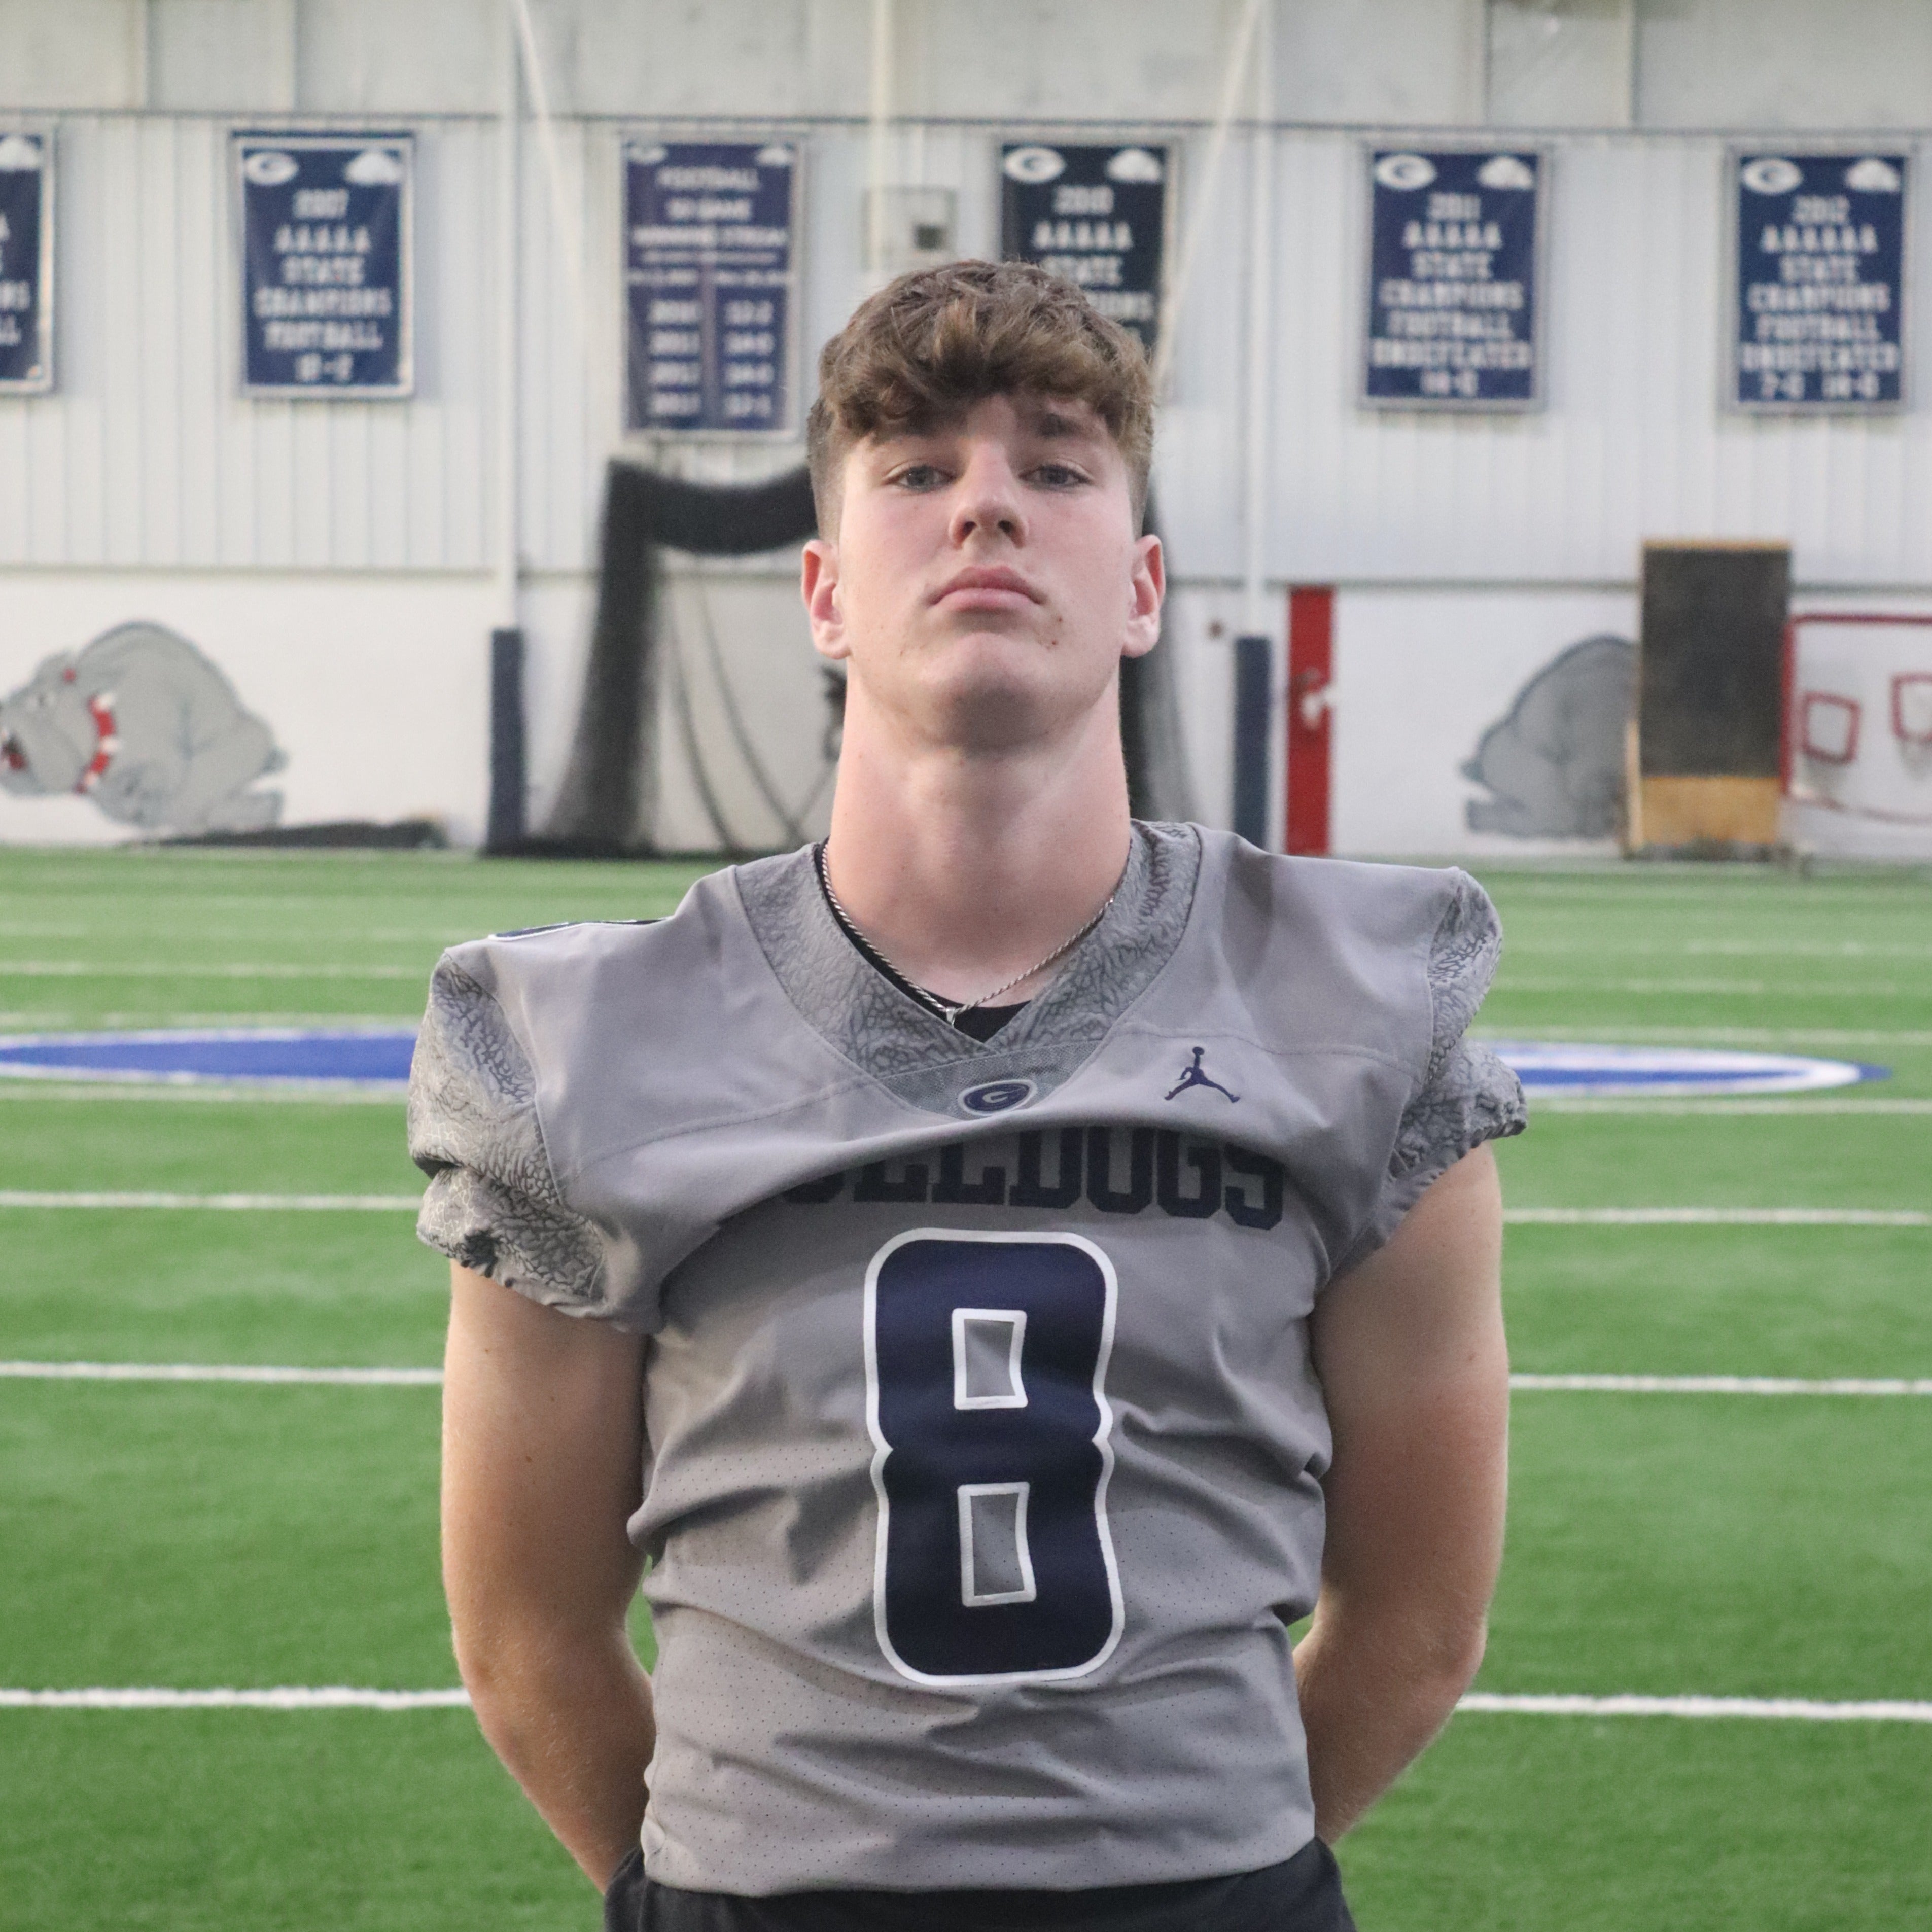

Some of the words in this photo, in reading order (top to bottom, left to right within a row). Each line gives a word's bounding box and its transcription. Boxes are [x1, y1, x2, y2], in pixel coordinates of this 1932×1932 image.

[657, 167, 759, 190] FOOTBALL
[1034, 221, 1132, 250] AAAAA
[1403, 221, 1501, 249] AAAAA
[283, 256, 364, 284] STATE
[1041, 256, 1122, 285] STATE
[1413, 253, 1492, 280] STATE
[1781, 255, 1859, 282] STATE
[256, 287, 391, 317] CHAMPIONS
[1381, 280, 1523, 309] CHAMPIONS
[1750, 283, 1889, 312] CHAMPIONS
[265, 321, 382, 350] FOOTBALL
[1389, 311, 1513, 337] FOOTBALL
[1758, 313, 1881, 341] FOOTBALL
[1373, 340, 1531, 368] UNDEFEATED
[1742, 342, 1898, 371] UNDEFEATED
[863, 1227, 1125, 1686] 8
